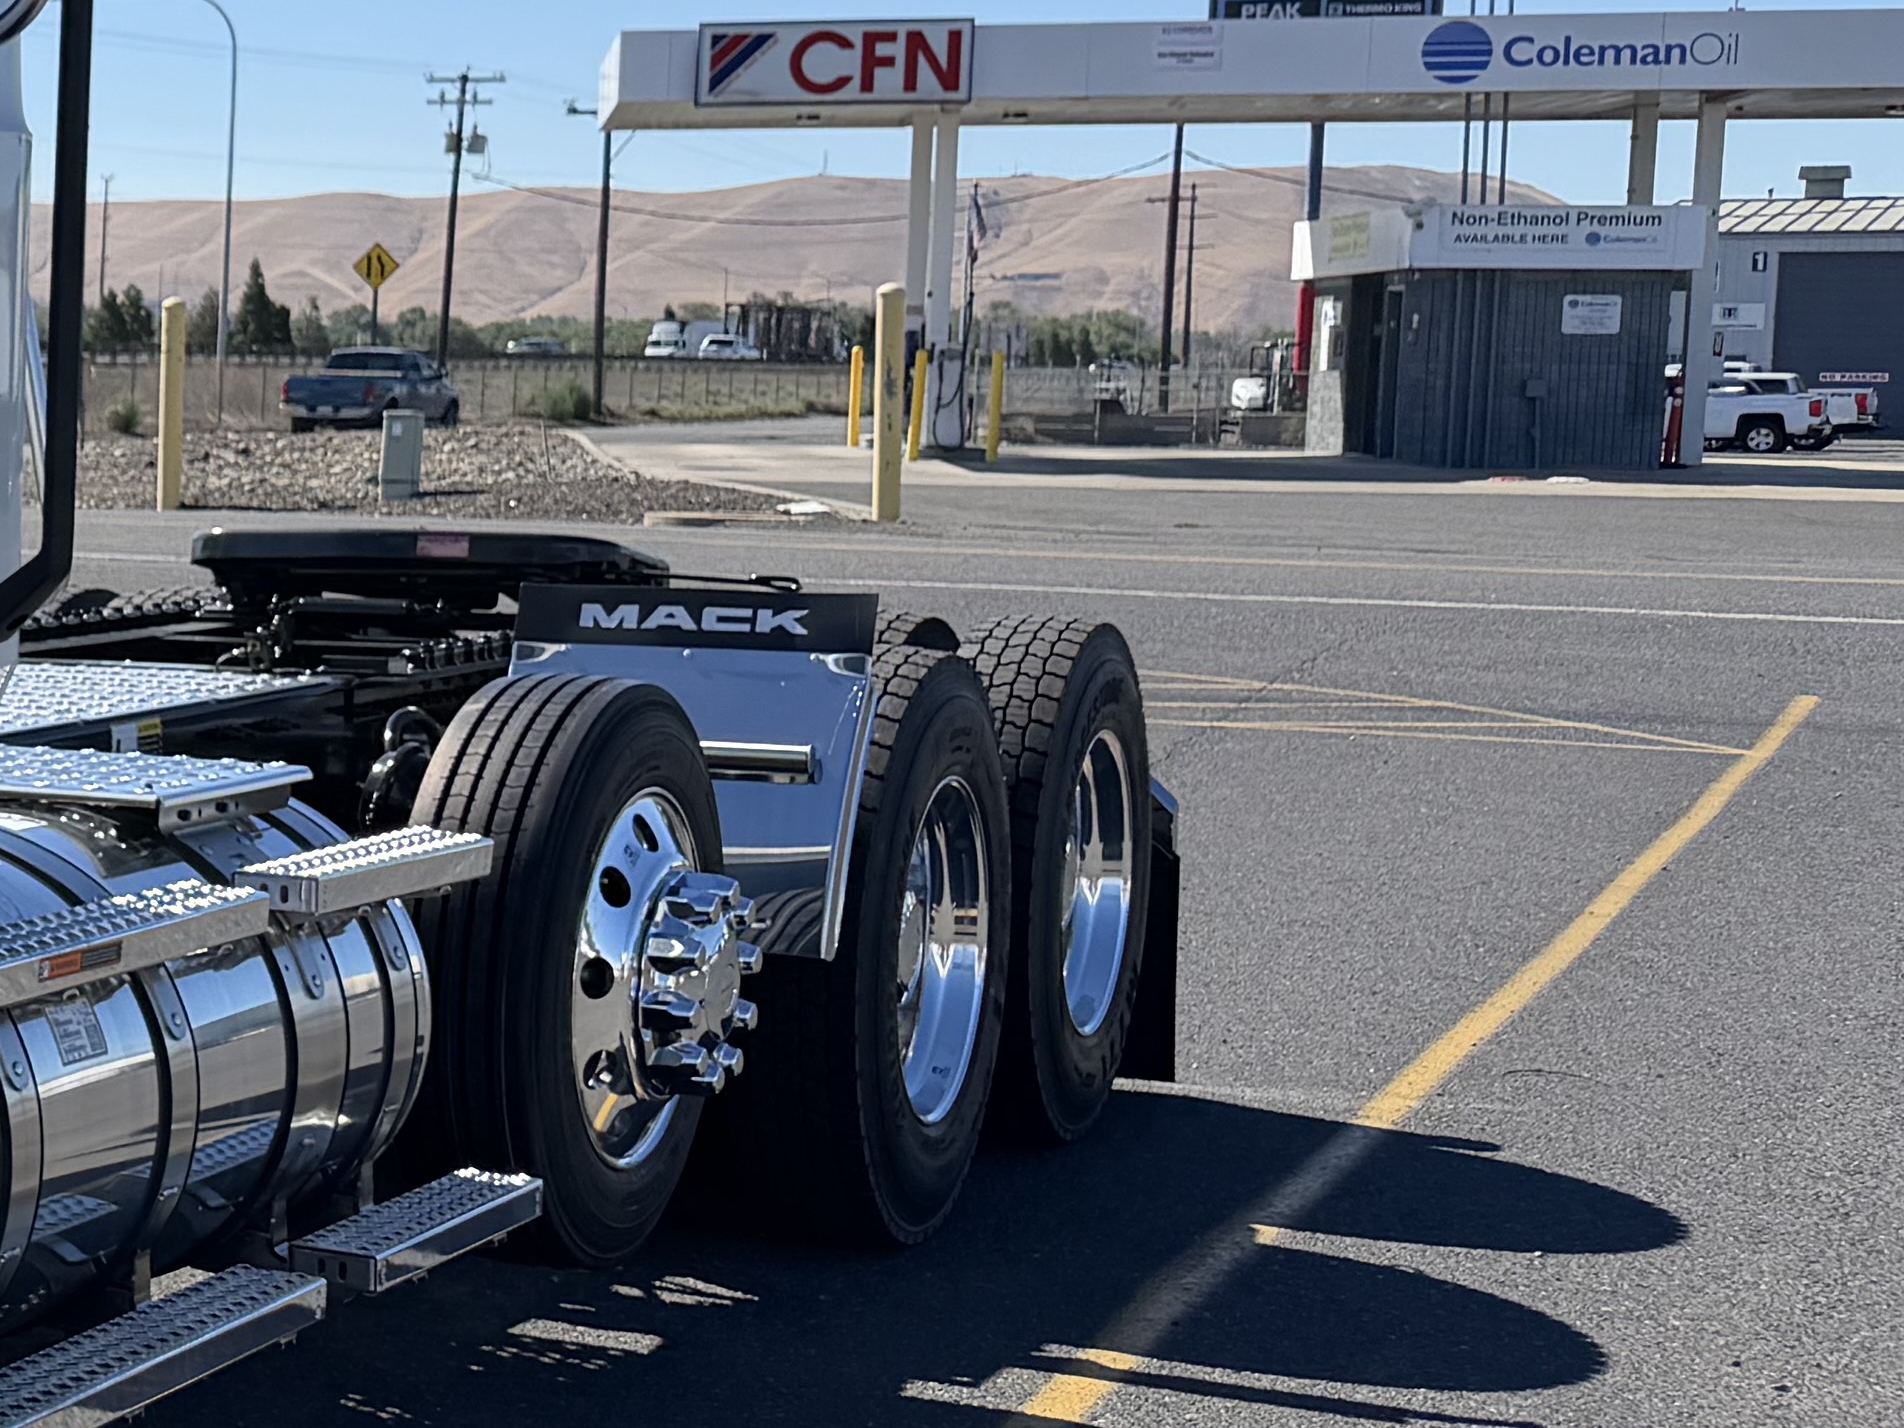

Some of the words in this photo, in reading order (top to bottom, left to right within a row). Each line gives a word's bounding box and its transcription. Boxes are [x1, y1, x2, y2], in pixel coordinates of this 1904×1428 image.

[1241, 1, 1302, 20] PEAK
[789, 28, 963, 95] CFN
[1450, 210, 1570, 228] Non-Ethanol
[1575, 210, 1664, 228] Premium
[1453, 233, 1529, 245] AVAILABLE
[1531, 233, 1569, 245] HERE
[1754, 253, 1765, 271] 1
[578, 602, 810, 636] MACK
